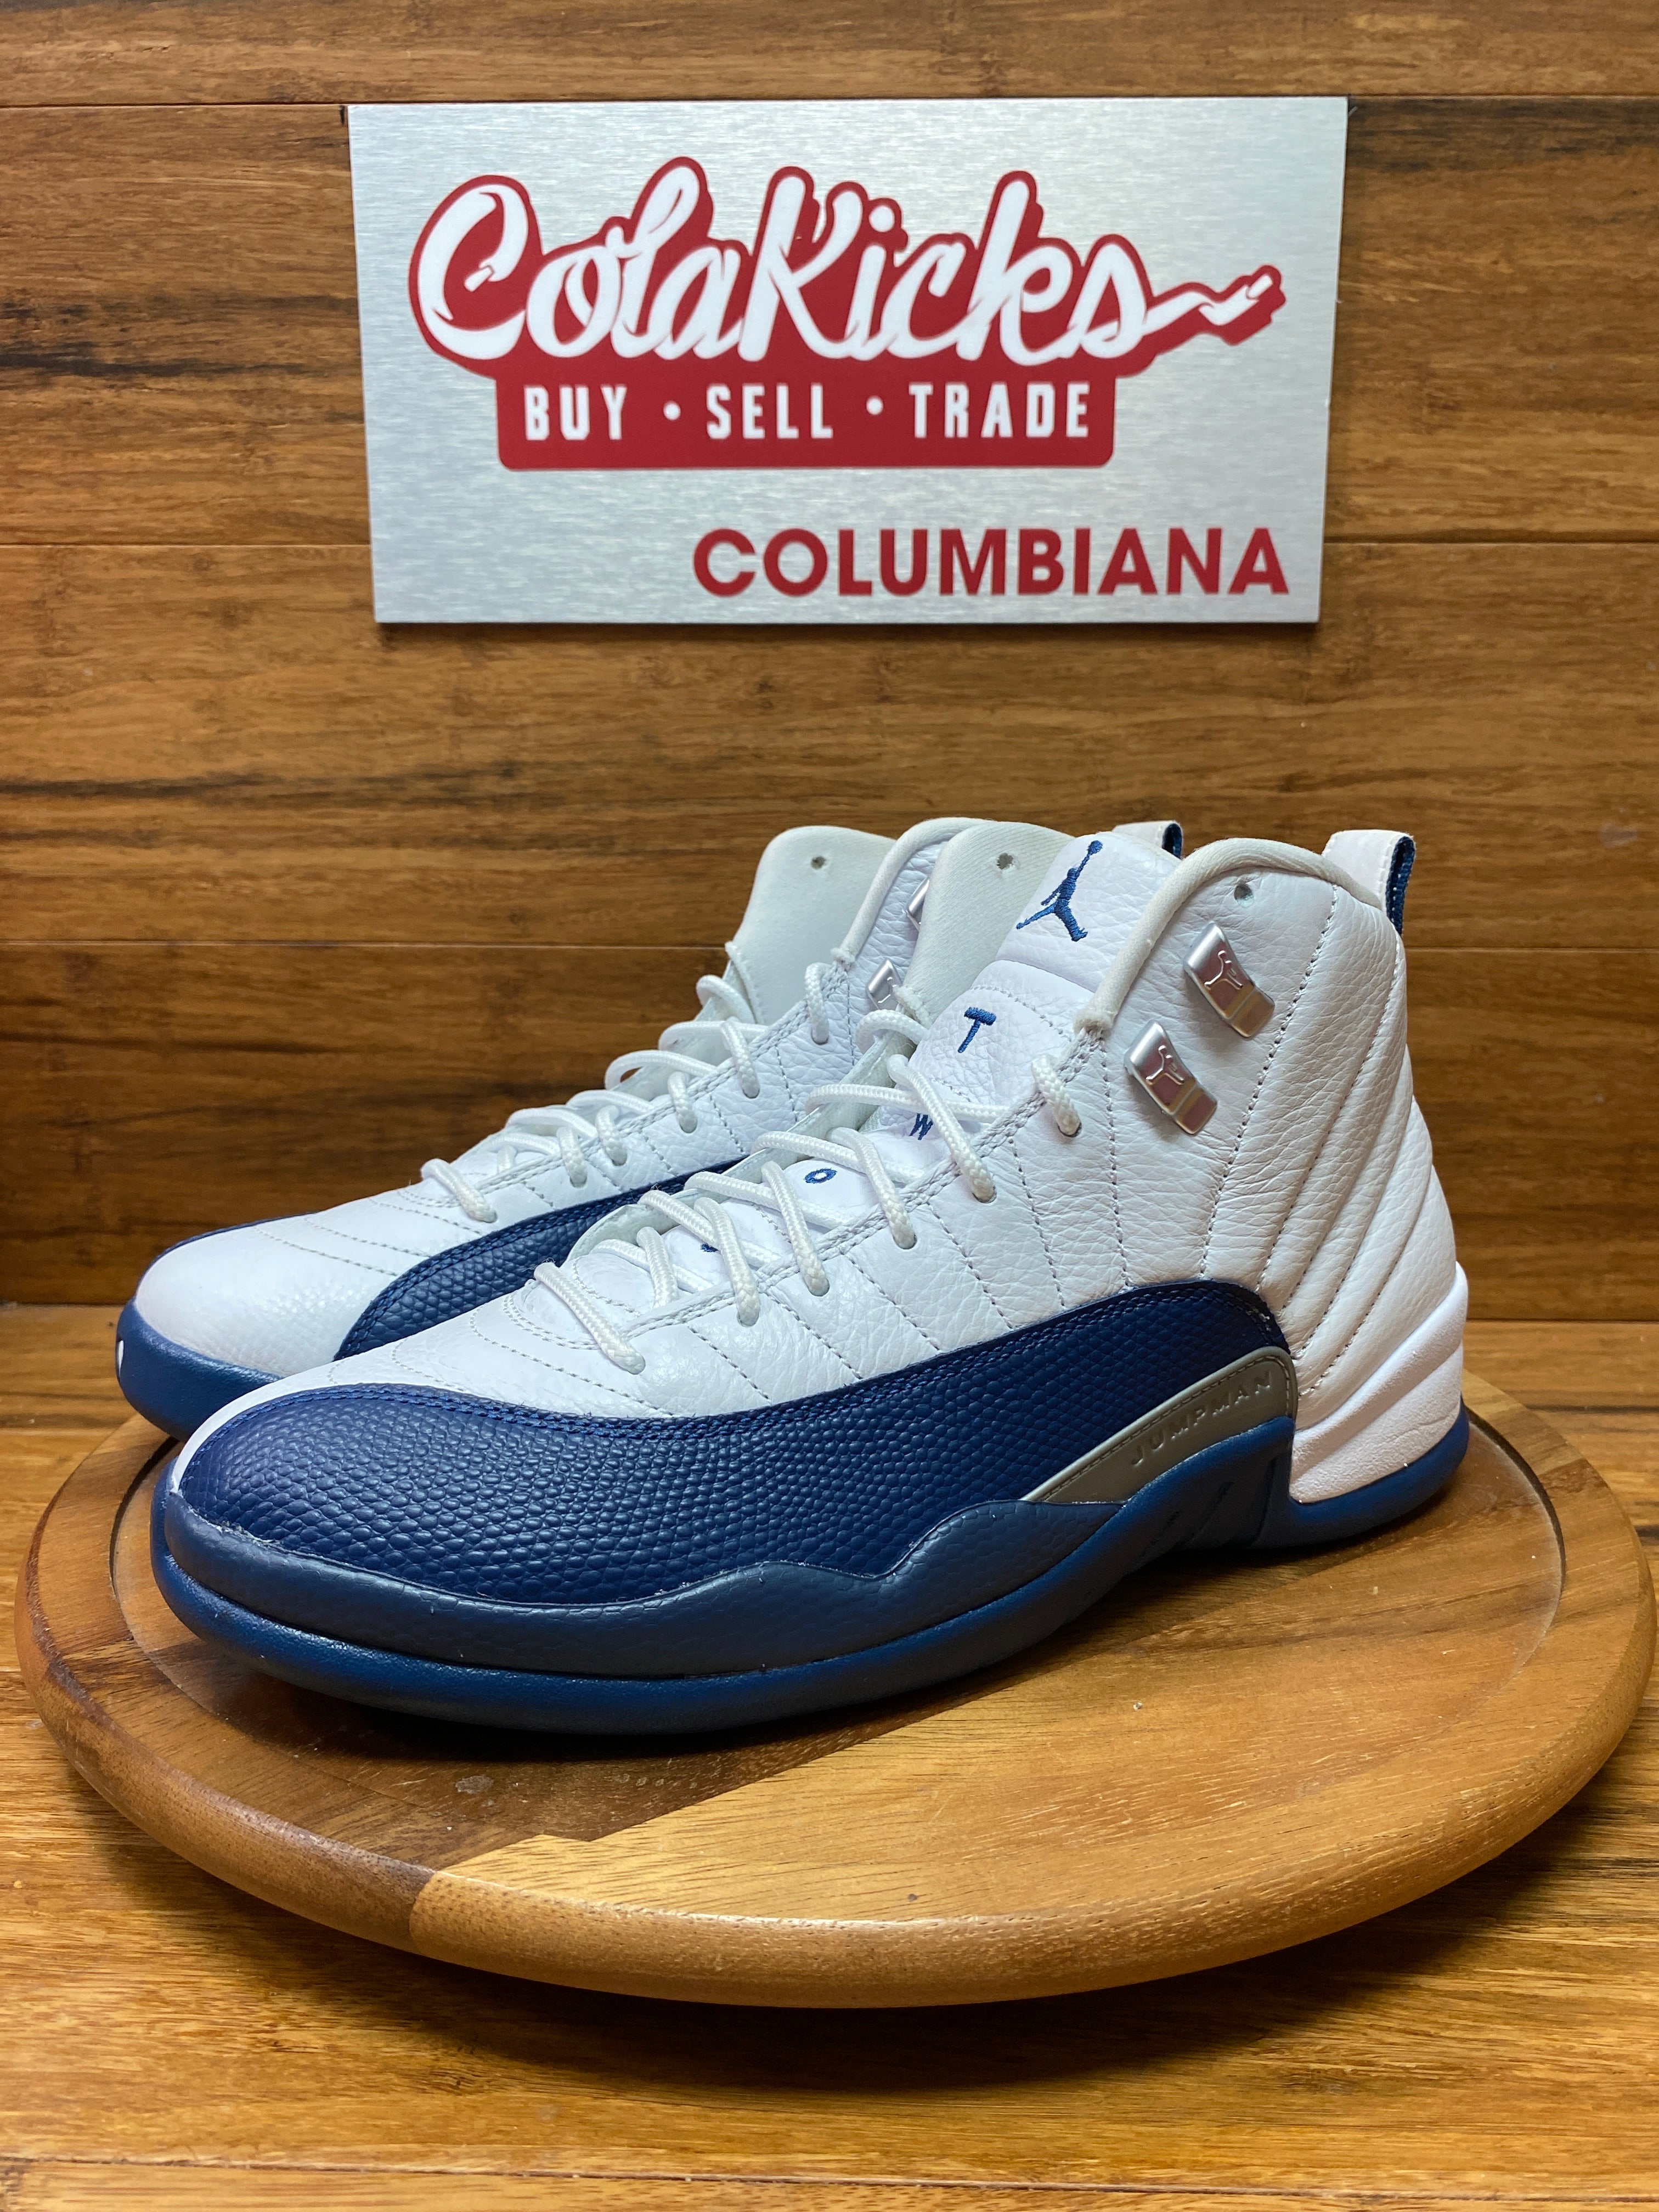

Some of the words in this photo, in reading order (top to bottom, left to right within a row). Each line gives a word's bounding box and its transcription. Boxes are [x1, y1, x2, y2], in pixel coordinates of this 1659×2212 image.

[417, 165, 1273, 366] ColaKicks
[524, 385, 627, 441] BUY
[706, 383, 833, 439] SELL
[909, 382, 1091, 438] TRADE
[693, 528, 1289, 596] COLUMBIANA
[1131, 1370, 1272, 1468] JUMPMAN
